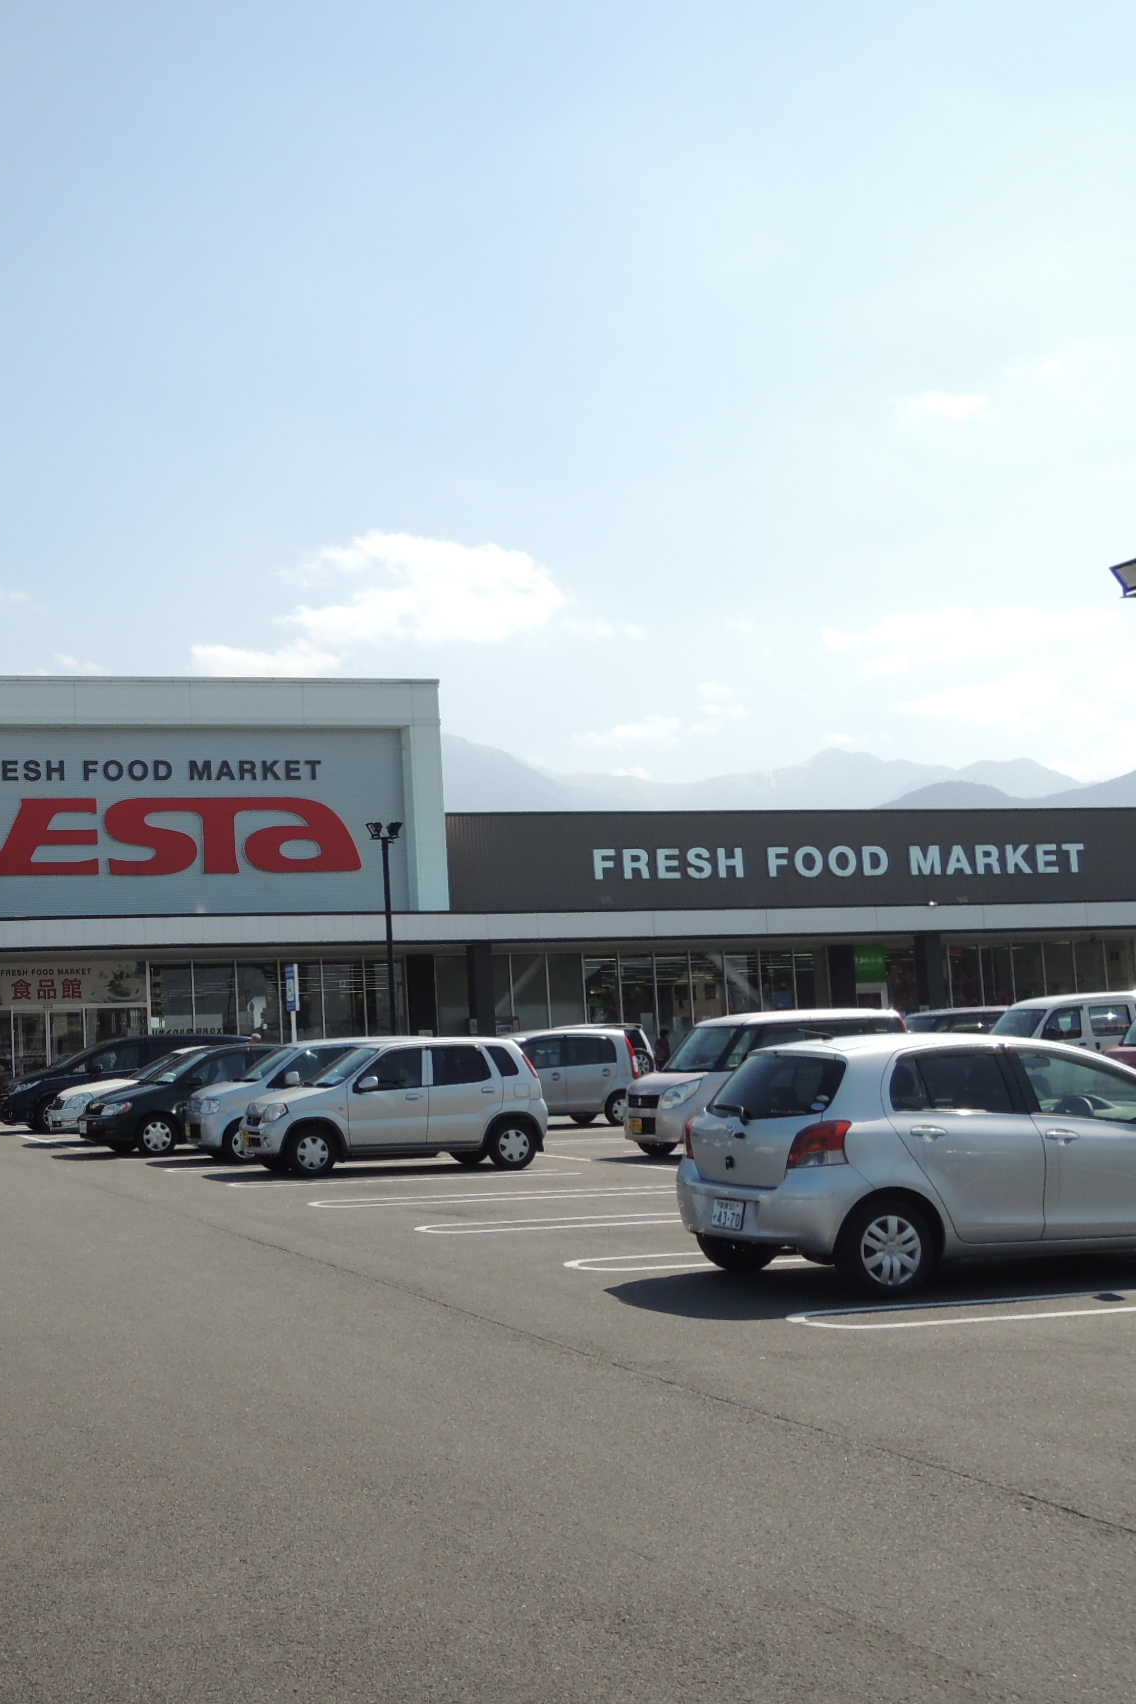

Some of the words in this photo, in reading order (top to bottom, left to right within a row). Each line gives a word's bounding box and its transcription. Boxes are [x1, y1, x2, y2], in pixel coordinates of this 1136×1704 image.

[82, 760, 174, 782] FOOD
[188, 759, 323, 781] MARKET
[592, 846, 745, 881] FRESH
[767, 844, 890, 879] FOOD
[908, 843, 1086, 877] MARKET
[0, 969, 28, 977] FRESH
[31, 968, 55, 976] FOOD
[57, 967, 92, 976] MARKET
[11, 978, 82, 1001] 食品館
